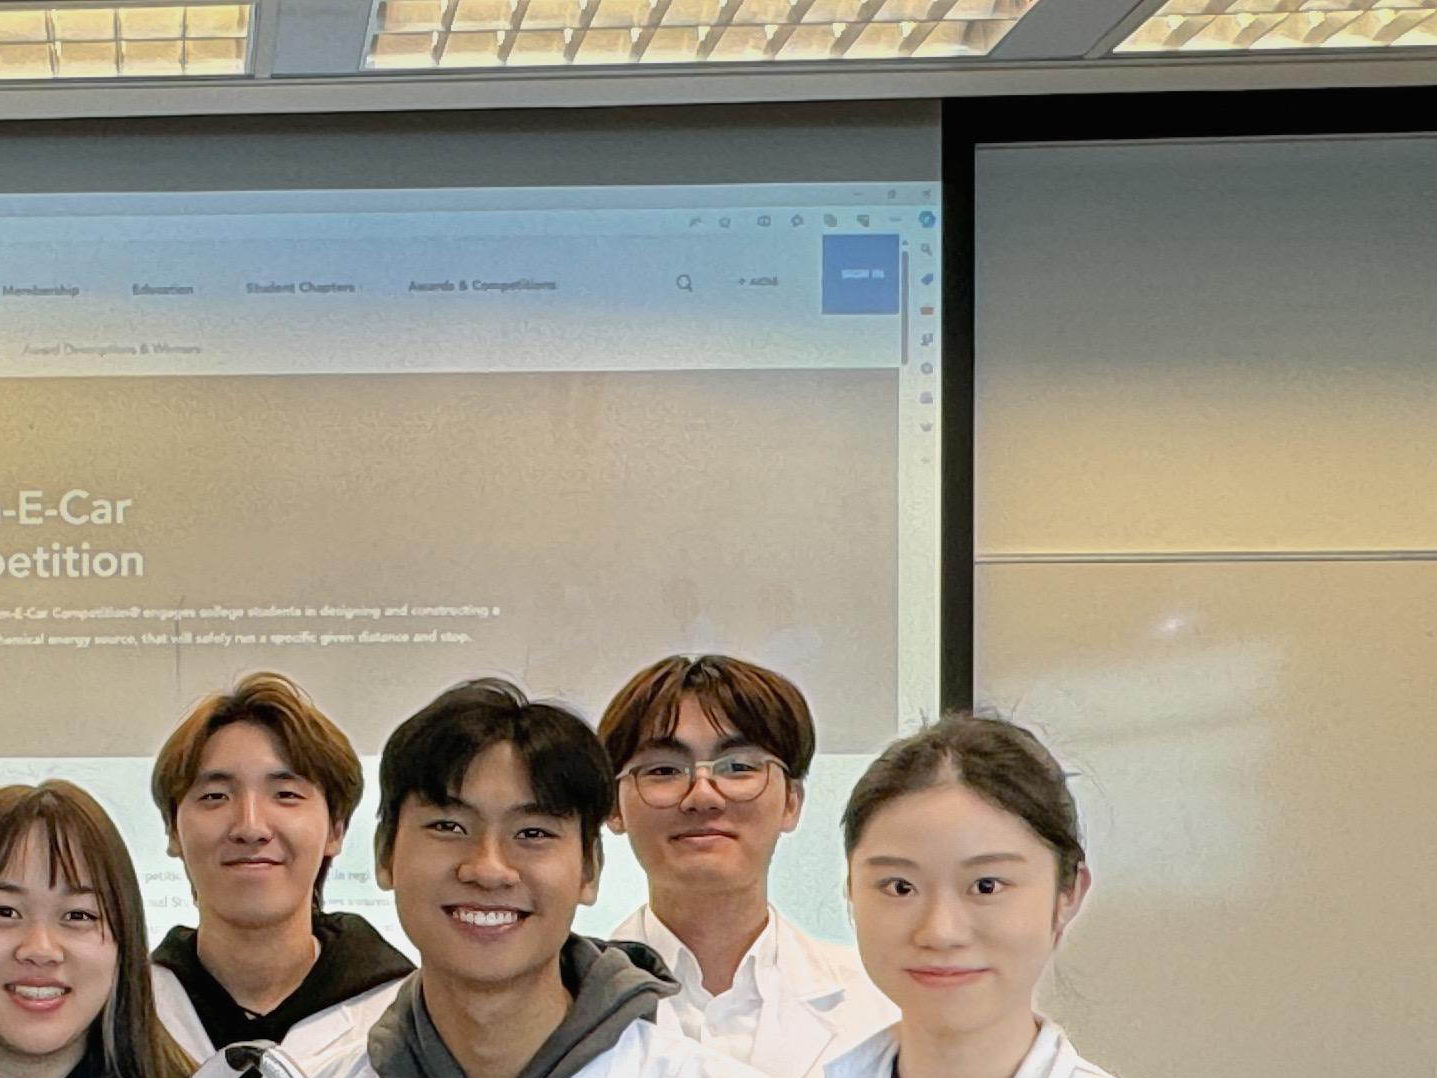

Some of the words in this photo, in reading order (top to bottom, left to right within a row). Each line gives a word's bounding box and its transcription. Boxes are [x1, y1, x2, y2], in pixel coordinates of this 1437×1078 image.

[2, 284, 80, 298] Membership
[132, 283, 194, 295] Education
[246, 281, 295, 294] Student
[299, 282, 355, 294] Chapters
[409, 280, 455, 292] Awards
[459, 281, 467, 292] &
[198, 605, 244, 620] college
[247, 605, 301, 618] students
[319, 604, 381, 620] designing
[384, 604, 408, 617] and
[411, 604, 489, 618] constructing
[48, 635, 92, 648] energy
[141, 632, 167, 645] that
[170, 631, 193, 645] will
[195, 631, 233, 647] safely
[235, 634, 256, 645] run
[269, 630, 317, 646] specific
[320, 631, 355, 646] given
[358, 629, 410, 643] distance
[413, 628, 438, 643] and
